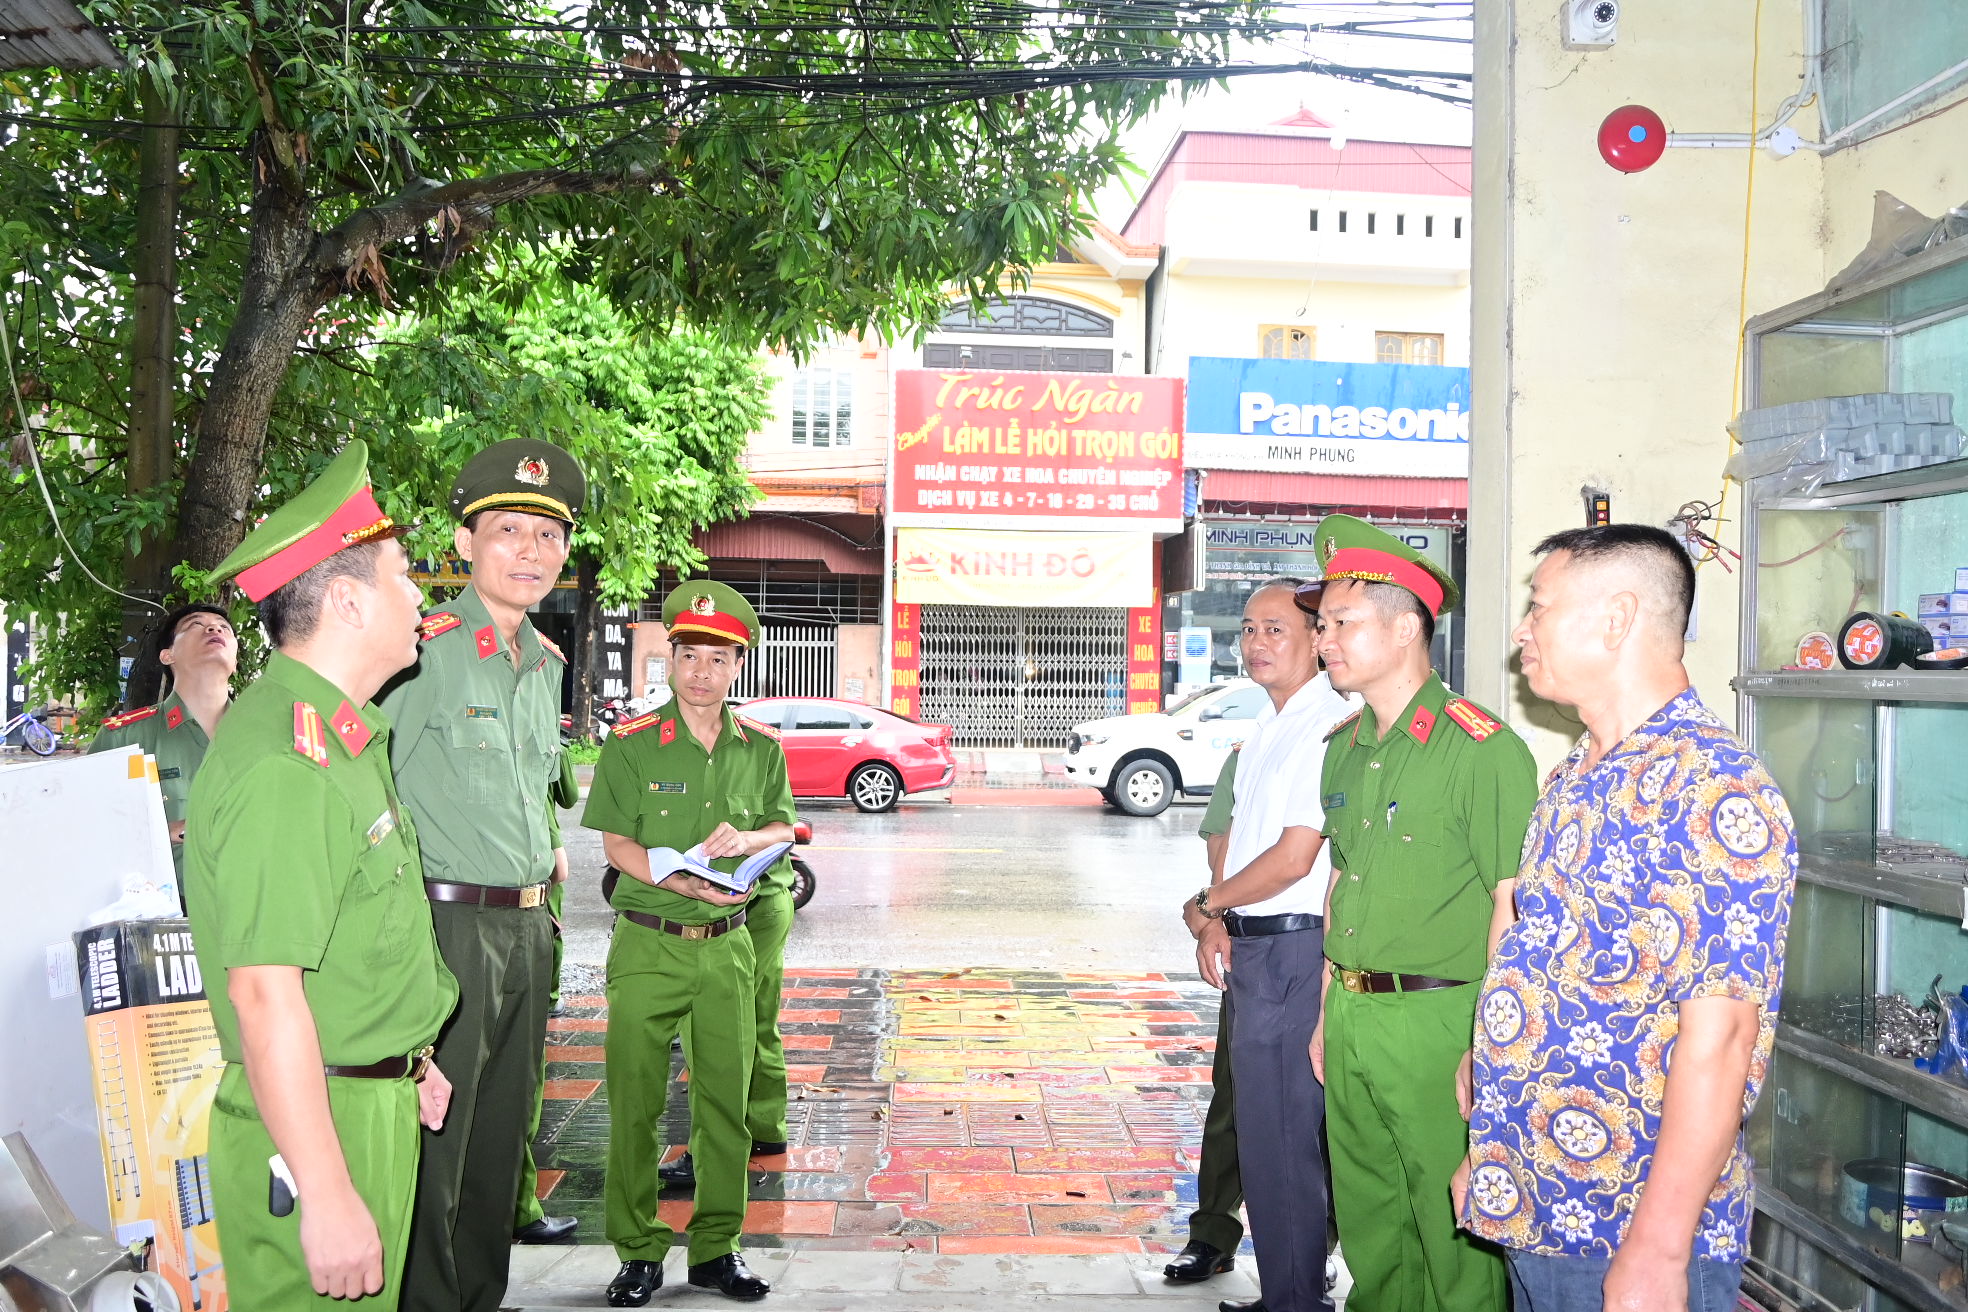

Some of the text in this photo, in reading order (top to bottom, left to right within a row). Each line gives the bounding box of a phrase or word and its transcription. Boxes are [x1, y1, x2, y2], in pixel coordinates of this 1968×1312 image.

[936, 373, 1143, 424] Trúc Ngàn
[943, 418, 1178, 463] LÀM LỄ HỎI TRỌN GÓI
[1268, 446, 1302, 460] MINH
[915, 462, 956, 483] NHẬN
[960, 465, 998, 485] CHẠY
[1002, 466, 1021, 483] XE
[1025, 467, 1054, 484] HOA
[1058, 466, 1116, 485] CHUYÊN
[918, 489, 952, 508] DỊCH
[956, 490, 976, 509] VỤ
[979, 491, 999, 507] XE
[1003, 491, 1013, 507] 4
[1026, 491, 1036, 508] 7
[1129, 489, 1159, 511] CHỖ
[1206, 529, 1314, 549] MINH PHỤN
[950, 547, 1096, 579] KINH ĐÔ
[898, 605, 910, 629] LỄ
[1138, 616, 1152, 633] XE
[605, 624, 626, 646] DA,
[895, 635, 912, 658] HỎI
[1134, 644, 1154, 661] HOA
[606, 651, 622, 671] YA
[892, 669, 917, 690] TRỌN
[1130, 670, 1159, 690] CHUYÊN
[893, 694, 911, 715] GÓI
[153, 932, 181, 952] 4.1M
[87, 942, 100, 989] TELESCOPIC
[97, 938, 122, 1008] LADDER
[155, 954, 204, 997] LAD
